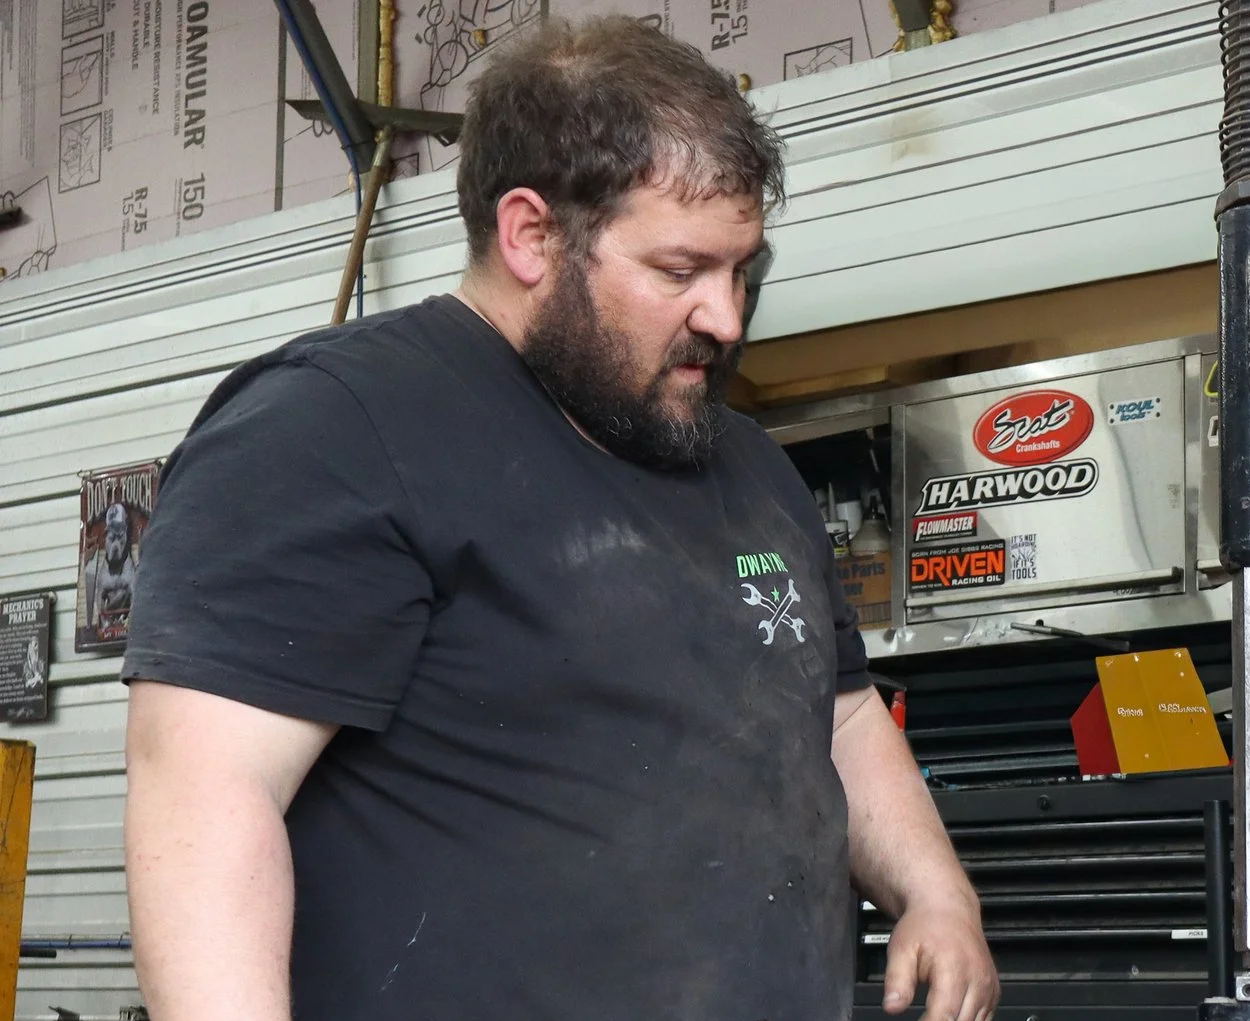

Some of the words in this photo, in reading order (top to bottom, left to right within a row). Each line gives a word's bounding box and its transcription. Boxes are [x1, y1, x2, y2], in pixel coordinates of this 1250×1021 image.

[143, 2, 151, 48] DURABLE
[152, 52, 161, 116] RESISTANCE
[182, 172, 205, 221] 150
[987, 399, 1074, 453] Scat
[1016, 439, 1060, 453] Crankshafts
[87, 478, 118, 521] DON'T
[120, 474, 152, 512] TOUCH
[927, 463, 1094, 507] HARWOOD
[915, 516, 974, 541] FLOWMASTER
[912, 550, 1004, 586] DRIVEN
[1012, 568, 1037, 579] TOOLS
[1014, 560, 1020, 568] IF
[1021, 558, 1034, 568] IT'S
[952, 577, 984, 586] RACING
[2, 598, 44, 615] MECHANIC'S
[8, 610, 37, 625] PRAYER
